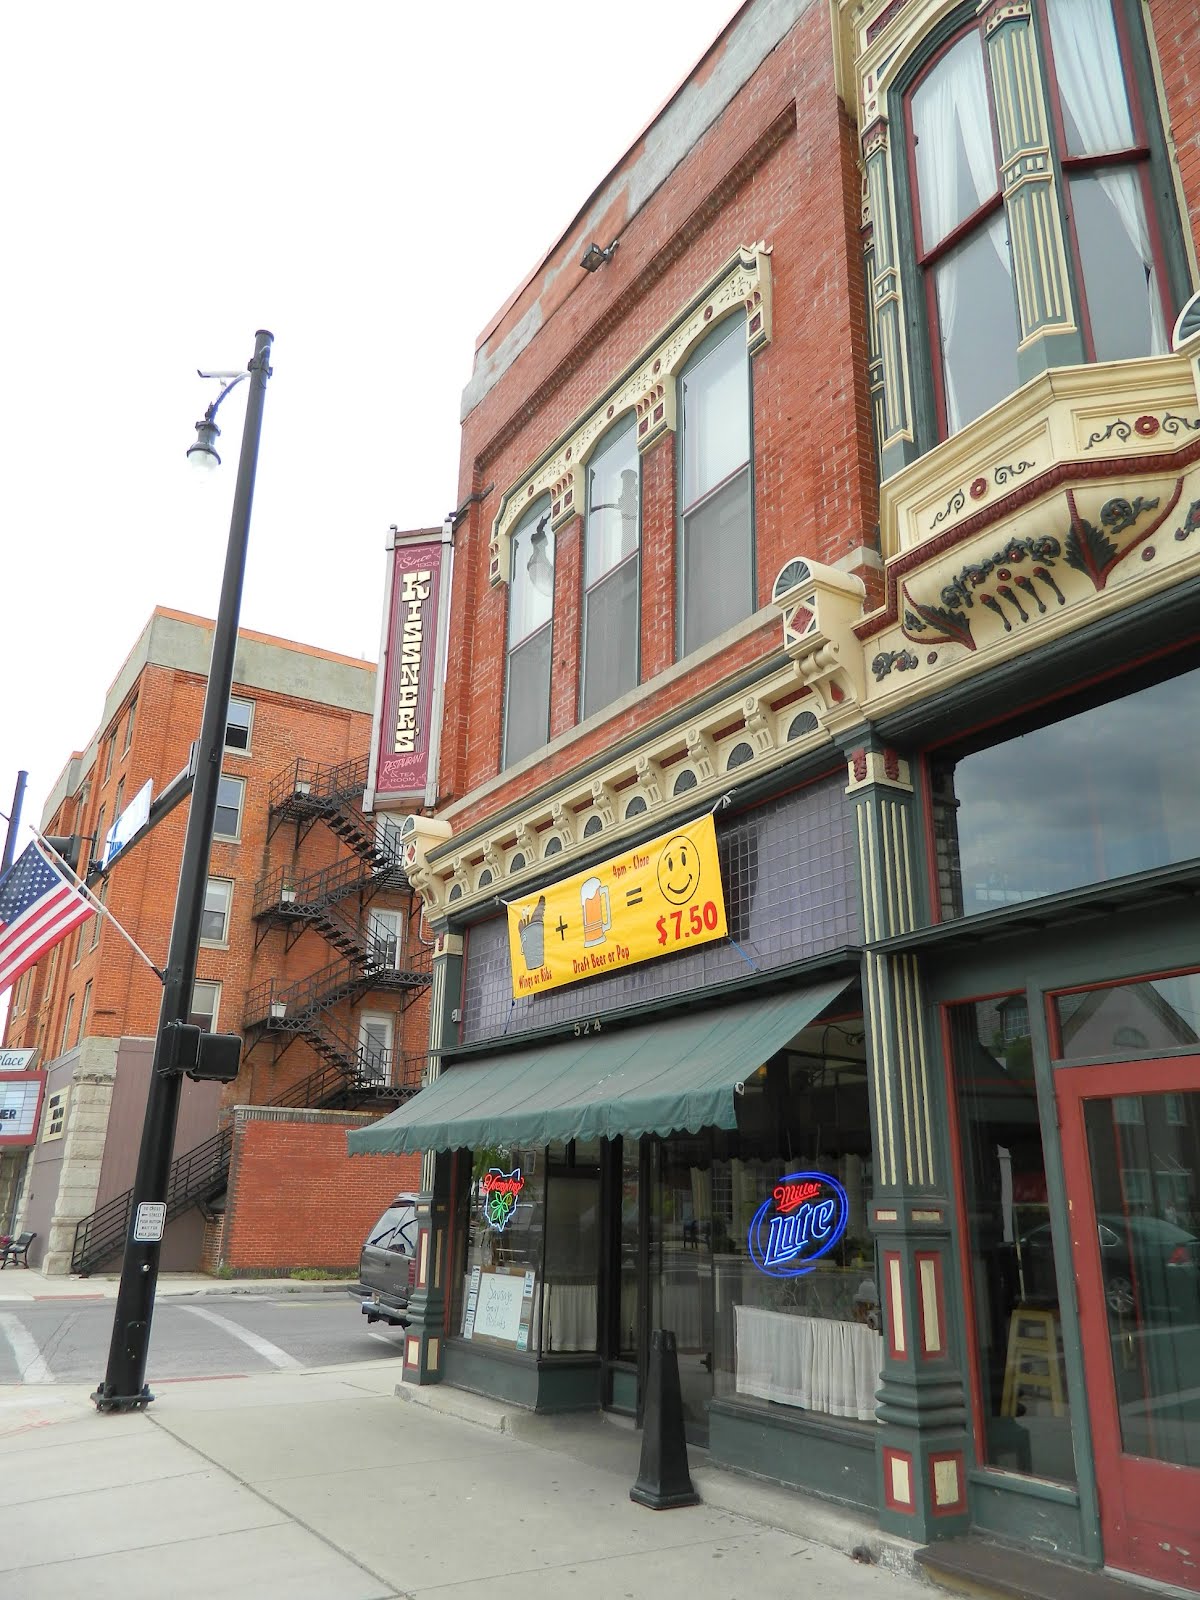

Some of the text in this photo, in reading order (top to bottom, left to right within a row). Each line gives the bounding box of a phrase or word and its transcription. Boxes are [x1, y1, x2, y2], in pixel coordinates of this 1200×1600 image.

[400, 554, 431, 569] Since
[390, 770, 399, 778] &
[612, 865, 627, 879] 4pm
[633, 854, 650, 870] Close
[656, 901, 718, 946] $7.50
[573, 945, 630, 974] Draft Beer or Pop
[519, 975, 534, 989] Wings
[534, 974, 540, 984] or
[574, 1018, 602, 1037] 524
[773, 1182, 821, 1212] Miller
[764, 1200, 834, 1266] Lite
